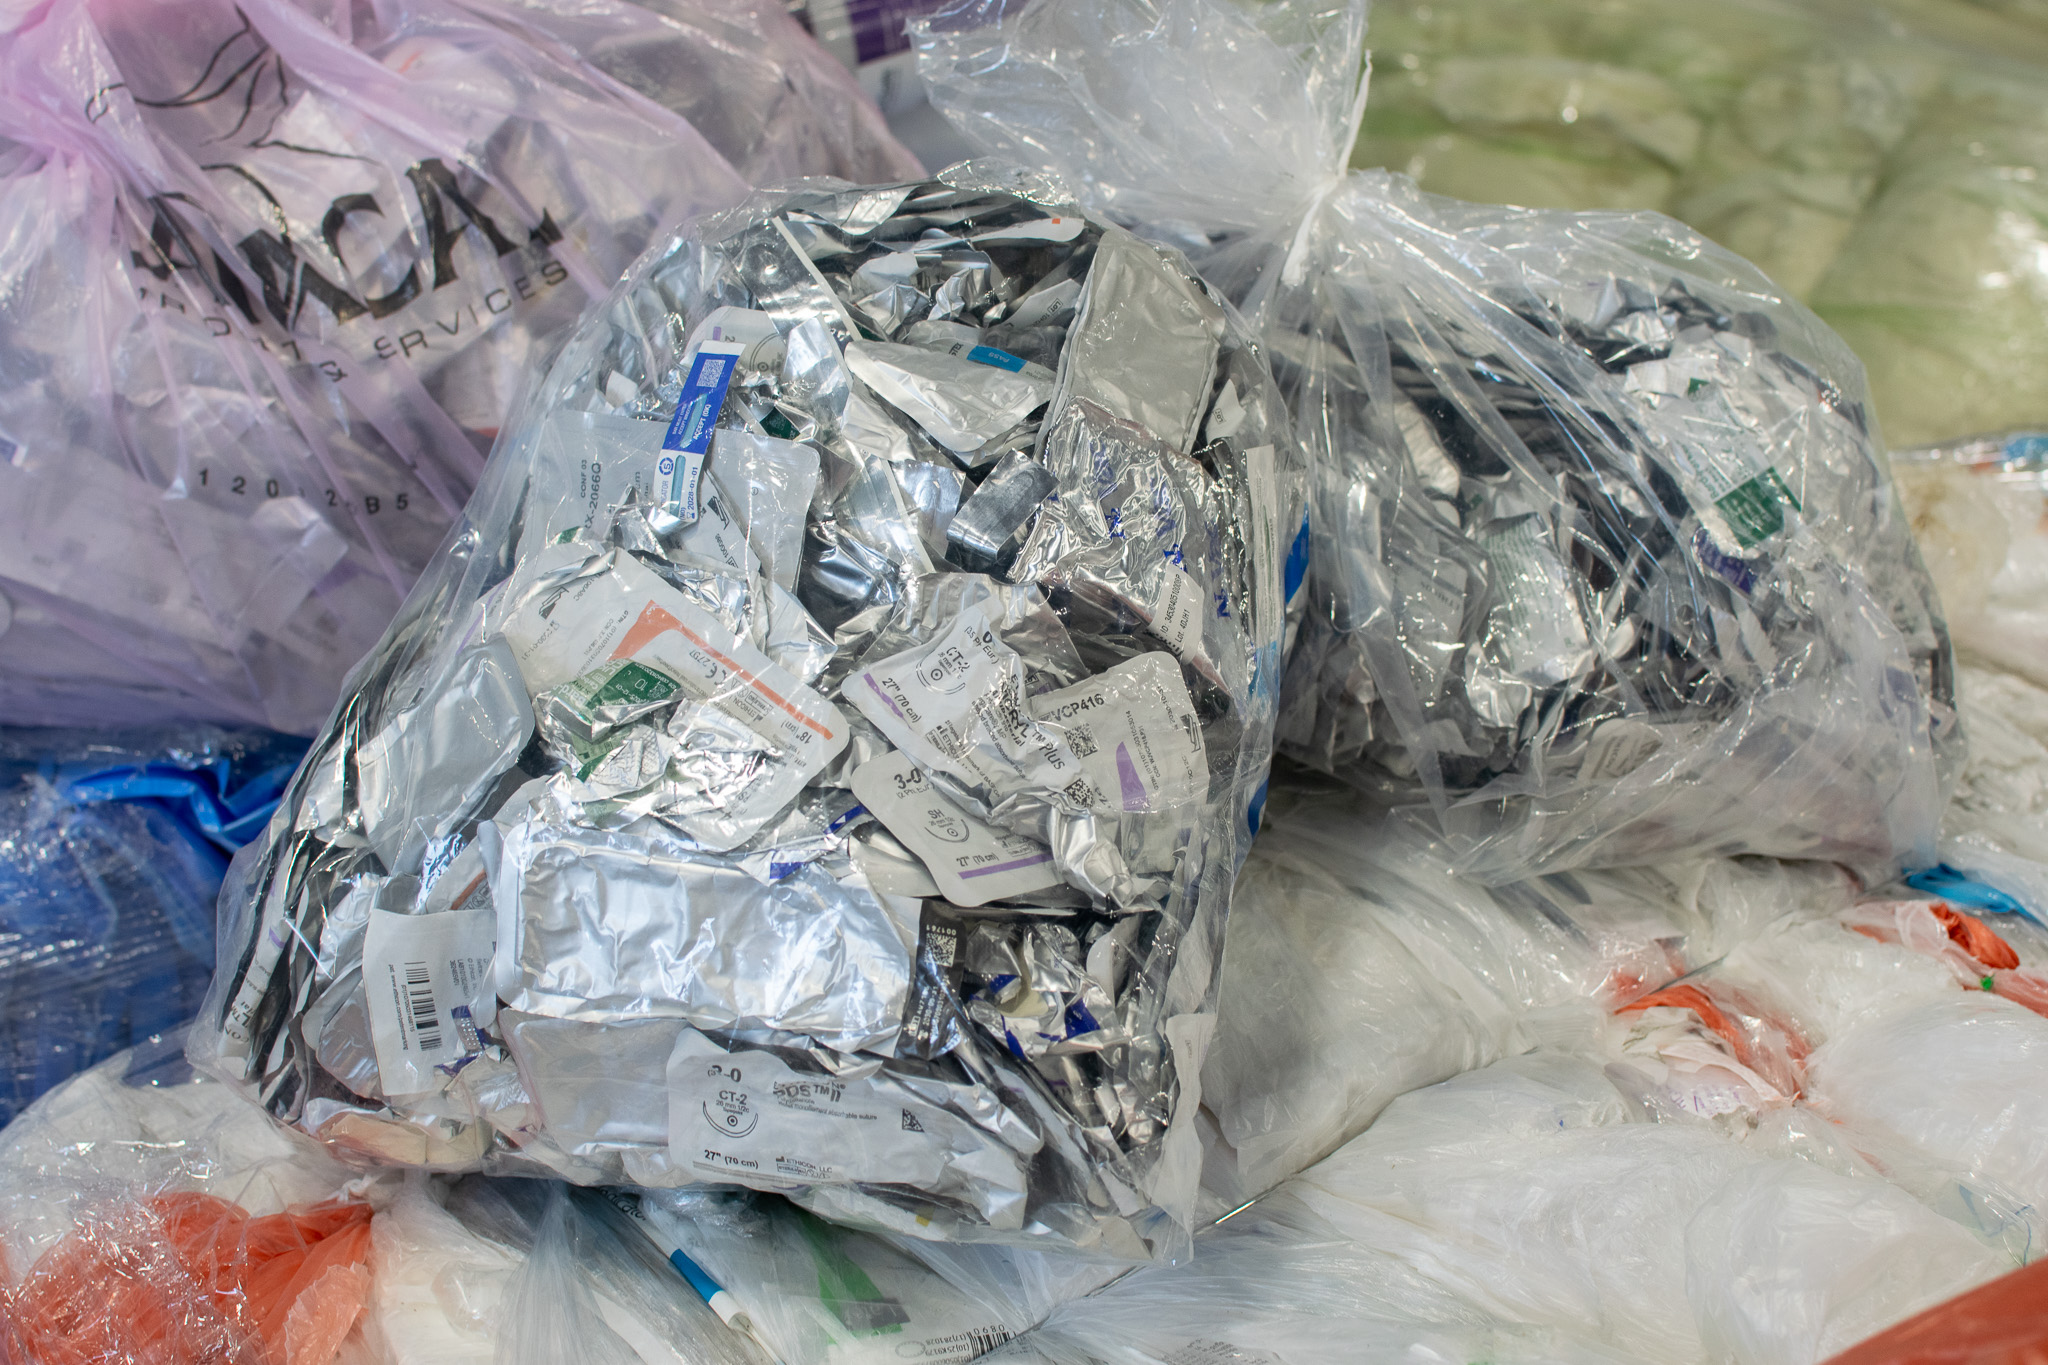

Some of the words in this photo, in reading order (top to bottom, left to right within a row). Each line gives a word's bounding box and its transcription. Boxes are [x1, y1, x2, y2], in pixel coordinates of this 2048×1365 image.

[372, 259, 568, 360] ERVICES
[1049, 300, 1061, 313] LOT
[988, 351, 1009, 362] PASS
[692, 416, 705, 439] ACCEPT
[581, 459, 588, 470] 03
[982, 643, 1000, 665] Eur.)
[633, 676, 648, 691] 10
[882, 676, 900, 698] 27"
[894, 692, 910, 708] (70
[1050, 692, 1105, 722] VCP416
[1038, 741, 1067, 771] Plus
[894, 769, 922, 788] 3-0
[927, 809, 945, 818] SH
[956, 856, 973, 868] 27"
[973, 853, 987, 867] (70
[926, 924, 956, 935] 001761
[719, 1089, 748, 1105] CT-2
[858, 1113, 877, 1121] suture
[703, 1149, 721, 1160] 27"
[724, 1155, 738, 1165] (70
[741, 1159, 759, 1169] cm)
[819, 1165, 832, 1173] LLC
[973, 1324, 1005, 1335] 0890
